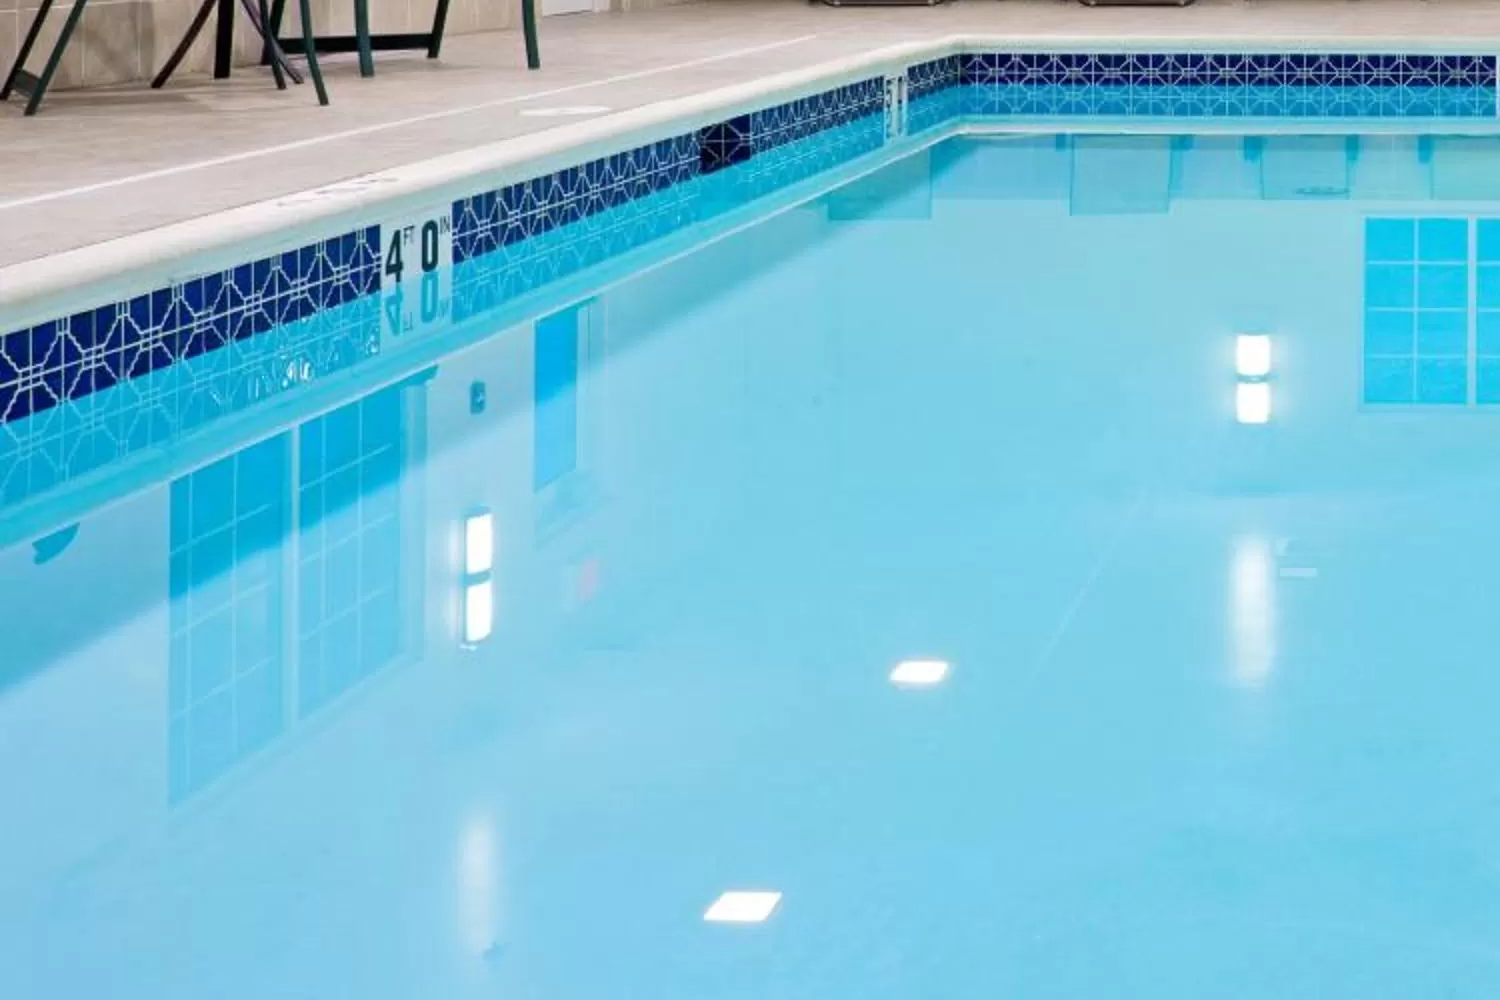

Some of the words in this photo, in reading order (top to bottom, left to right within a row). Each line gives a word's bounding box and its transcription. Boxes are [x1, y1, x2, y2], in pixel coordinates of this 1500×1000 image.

[385, 229, 403, 283] 4
[403, 224, 415, 247] FT
[421, 220, 439, 272] 0
